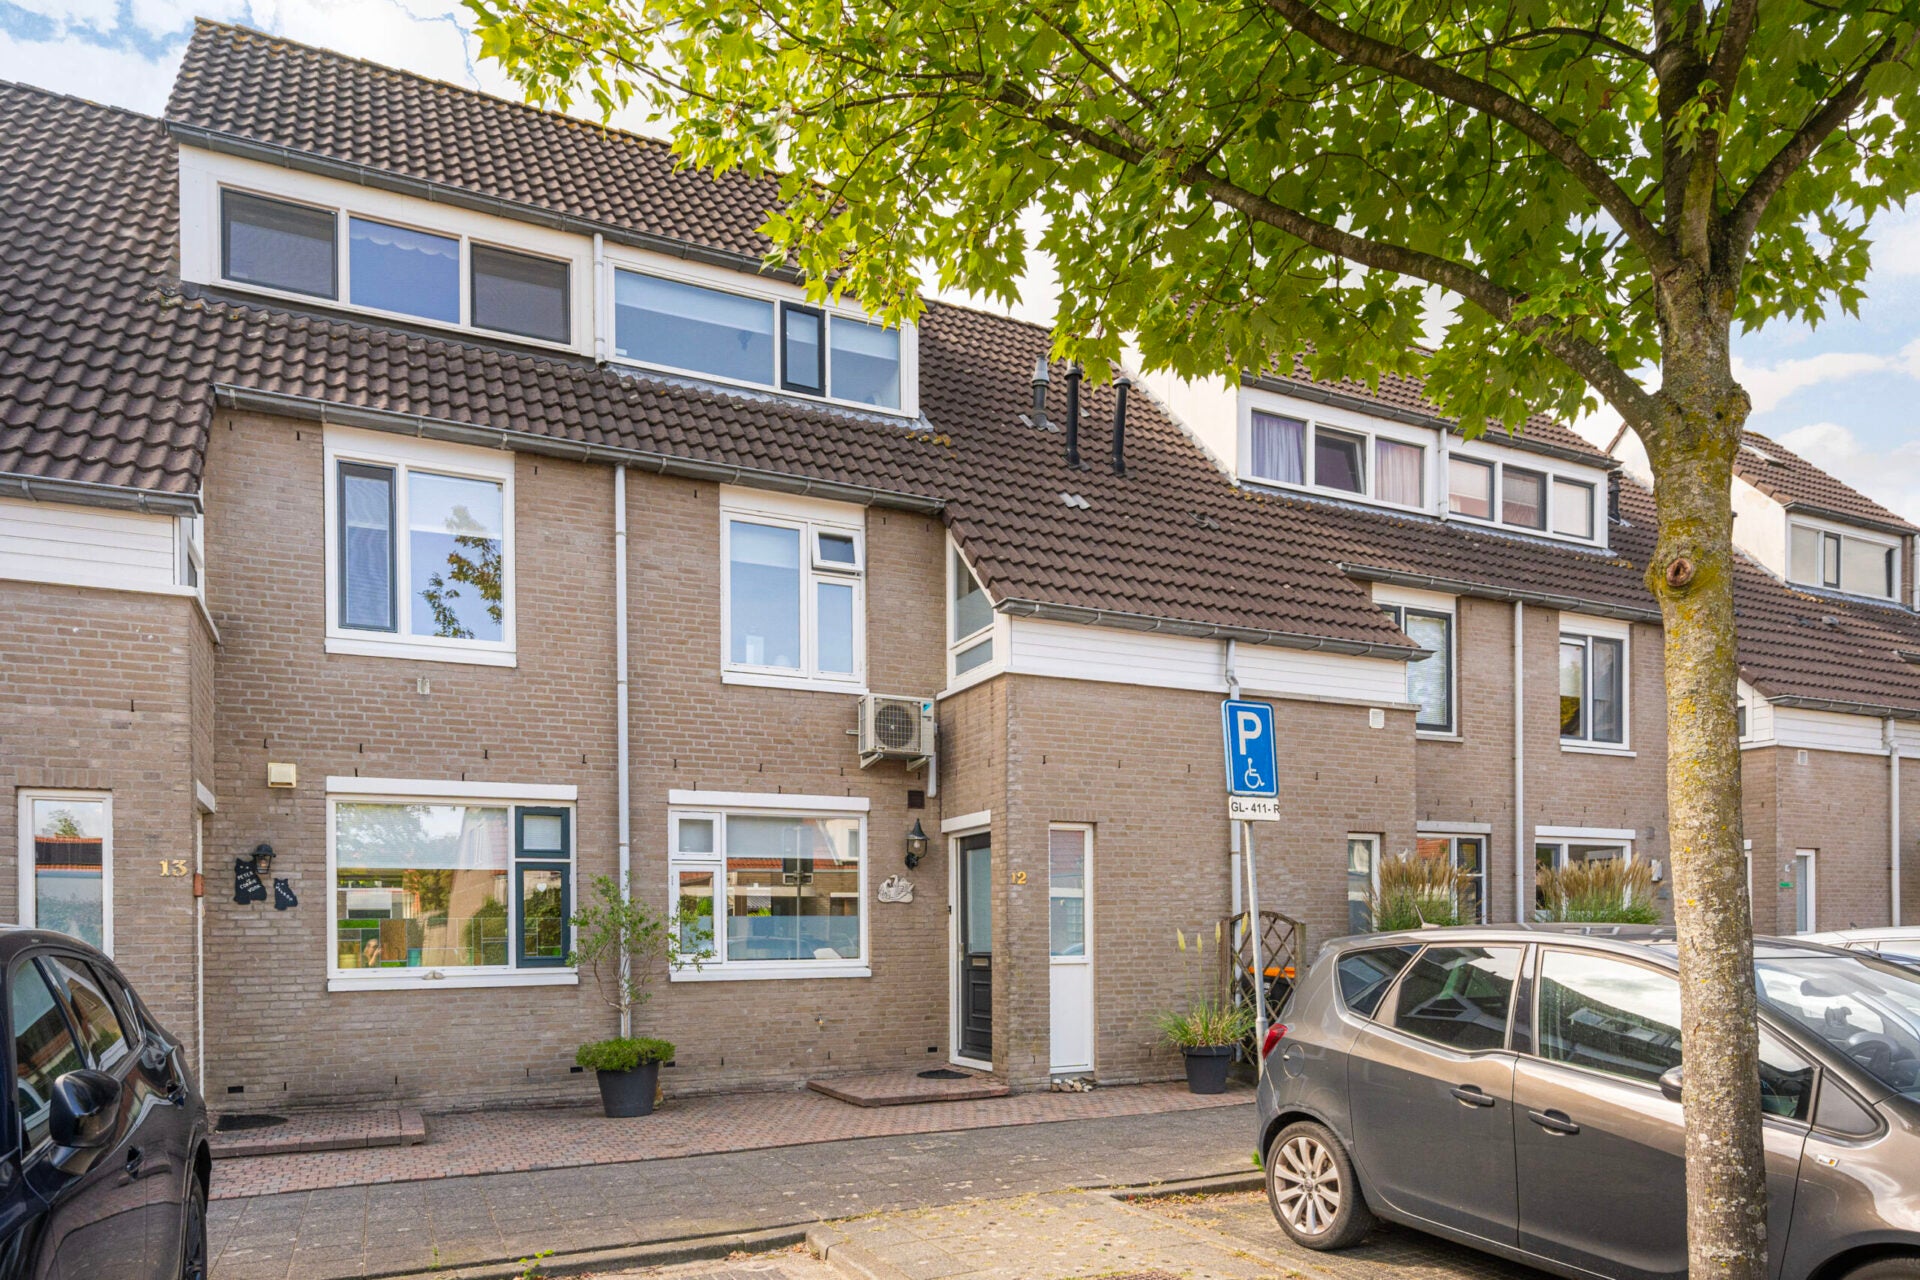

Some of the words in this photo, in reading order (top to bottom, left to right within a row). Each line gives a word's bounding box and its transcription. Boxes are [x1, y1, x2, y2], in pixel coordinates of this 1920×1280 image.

[1237, 710, 1263, 755] P
[159, 858, 188, 877] 13
[1011, 871, 1027, 885] 12
